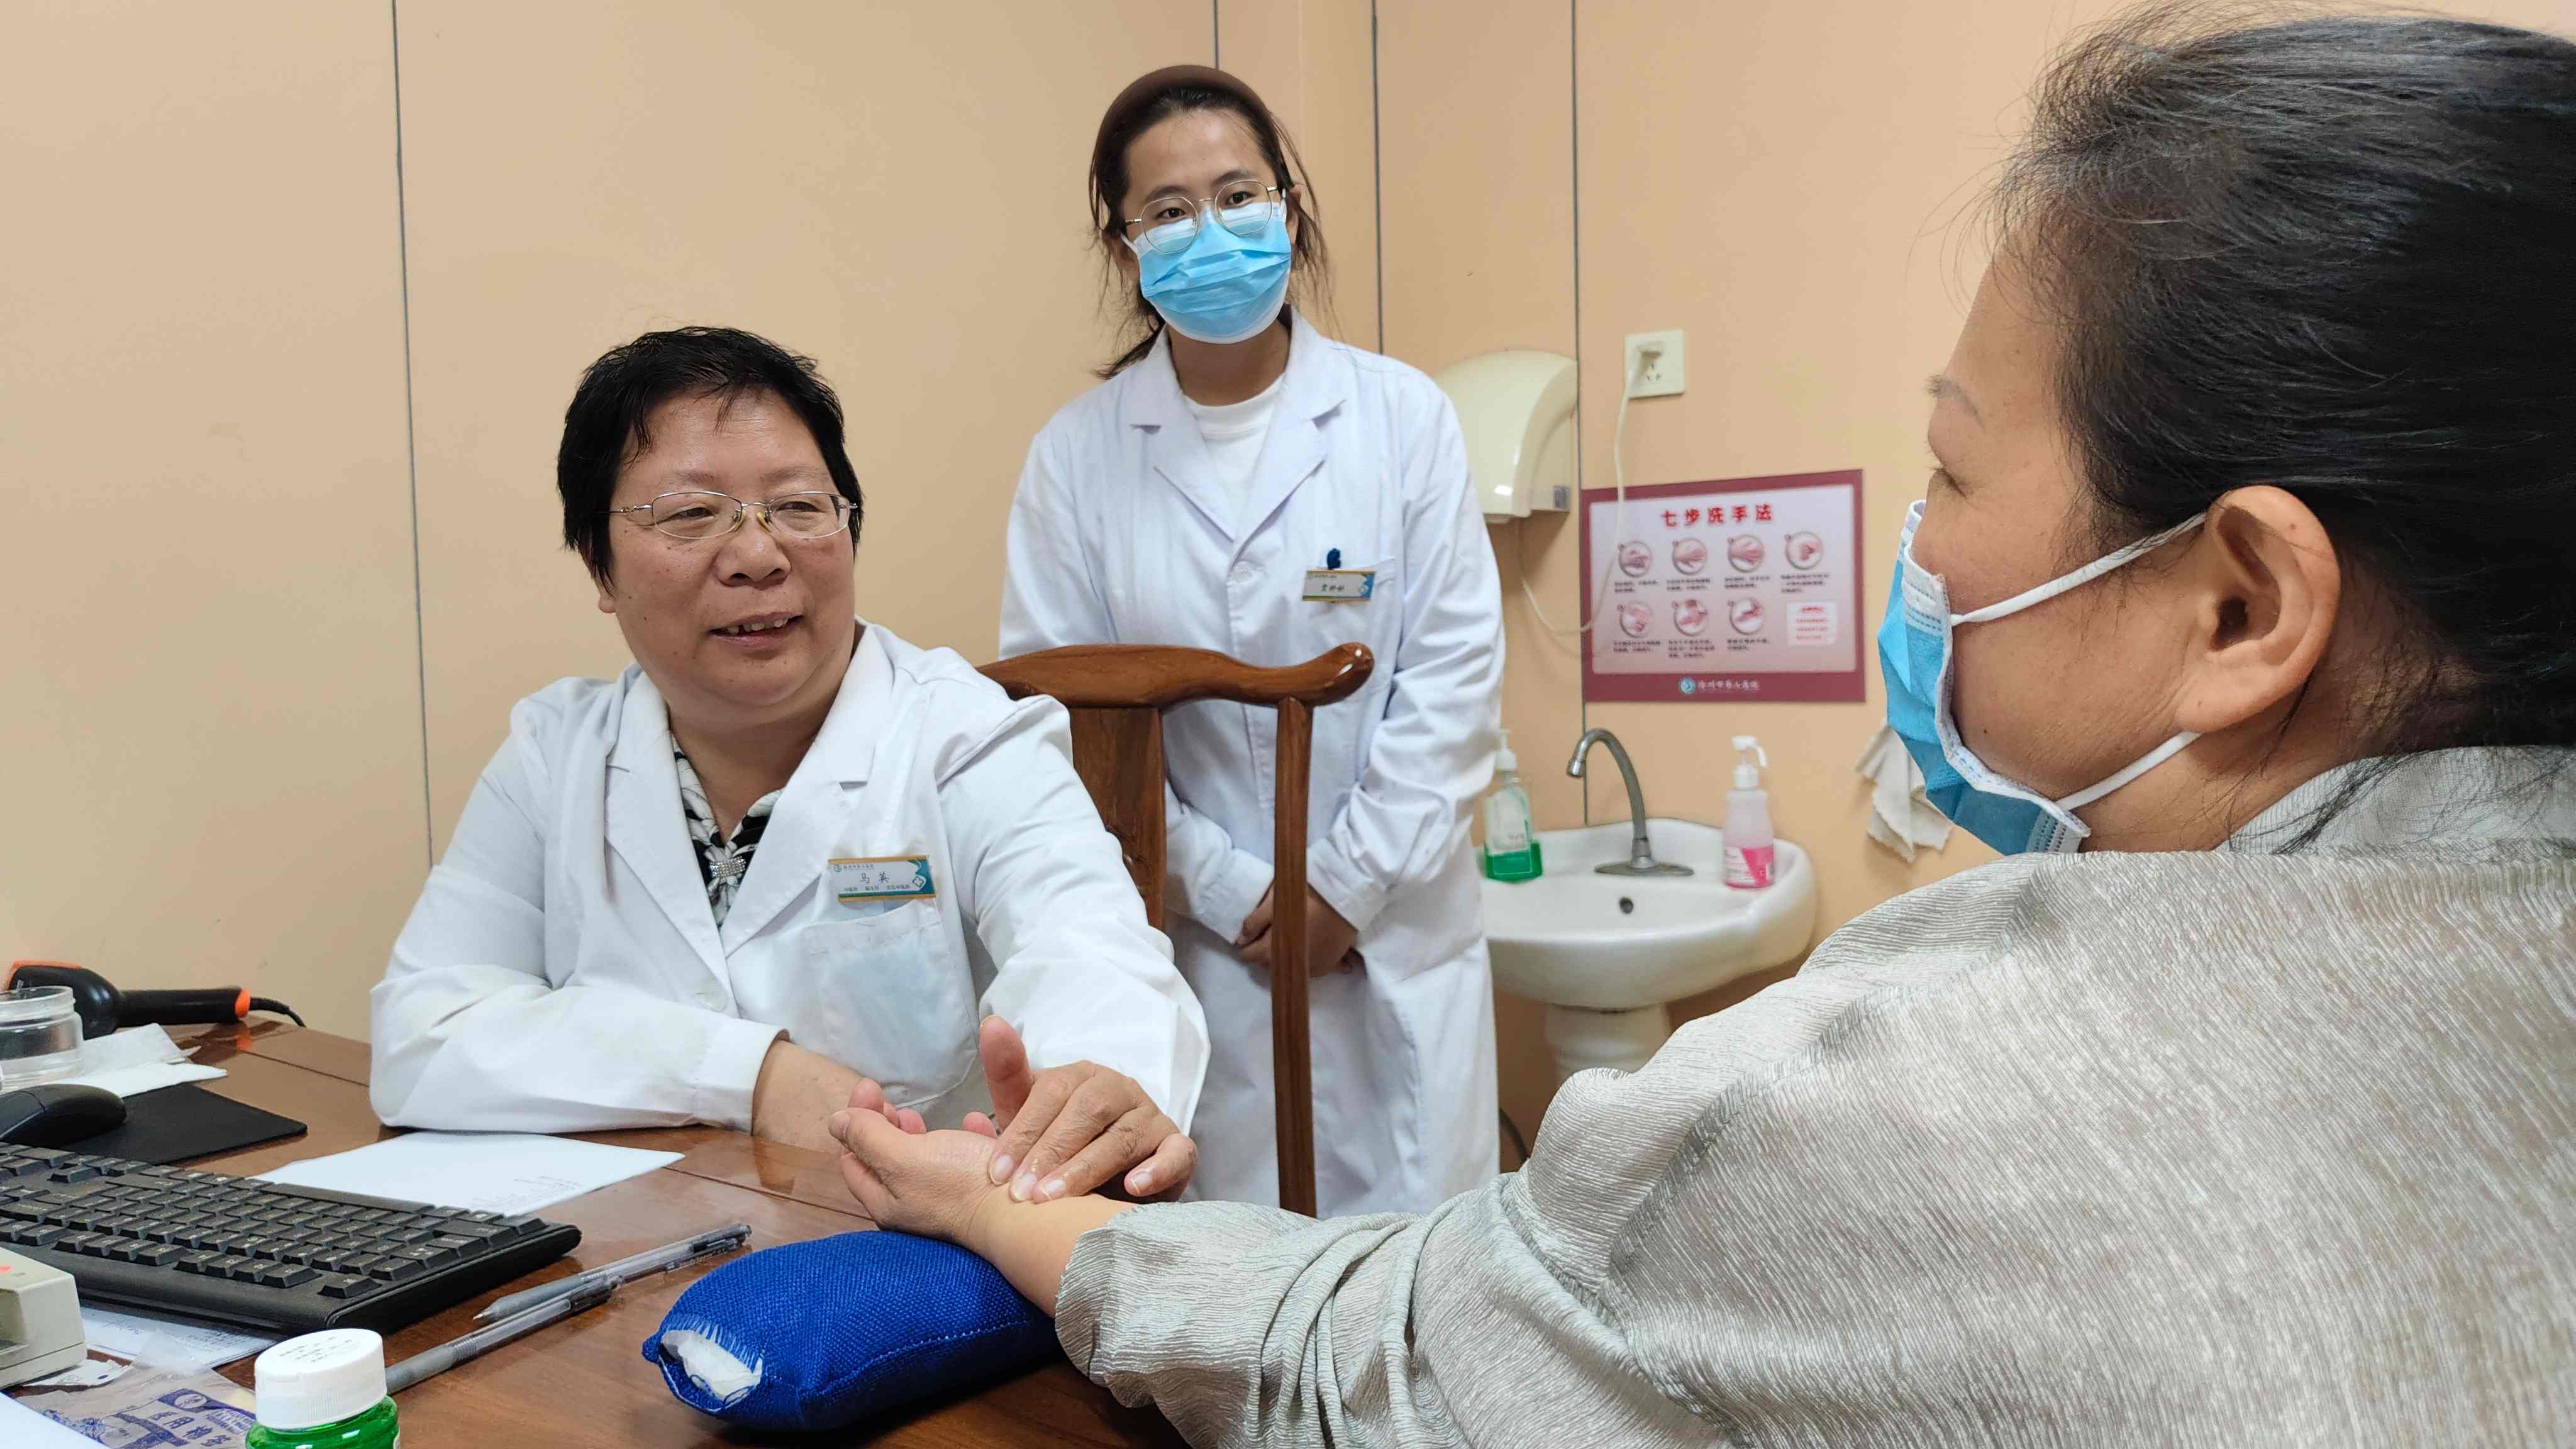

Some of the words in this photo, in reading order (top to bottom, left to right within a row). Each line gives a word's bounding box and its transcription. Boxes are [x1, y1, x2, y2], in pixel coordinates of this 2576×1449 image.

[1662, 503, 1772, 528] 七步洗手法
[860, 871, 890, 884] 马英
